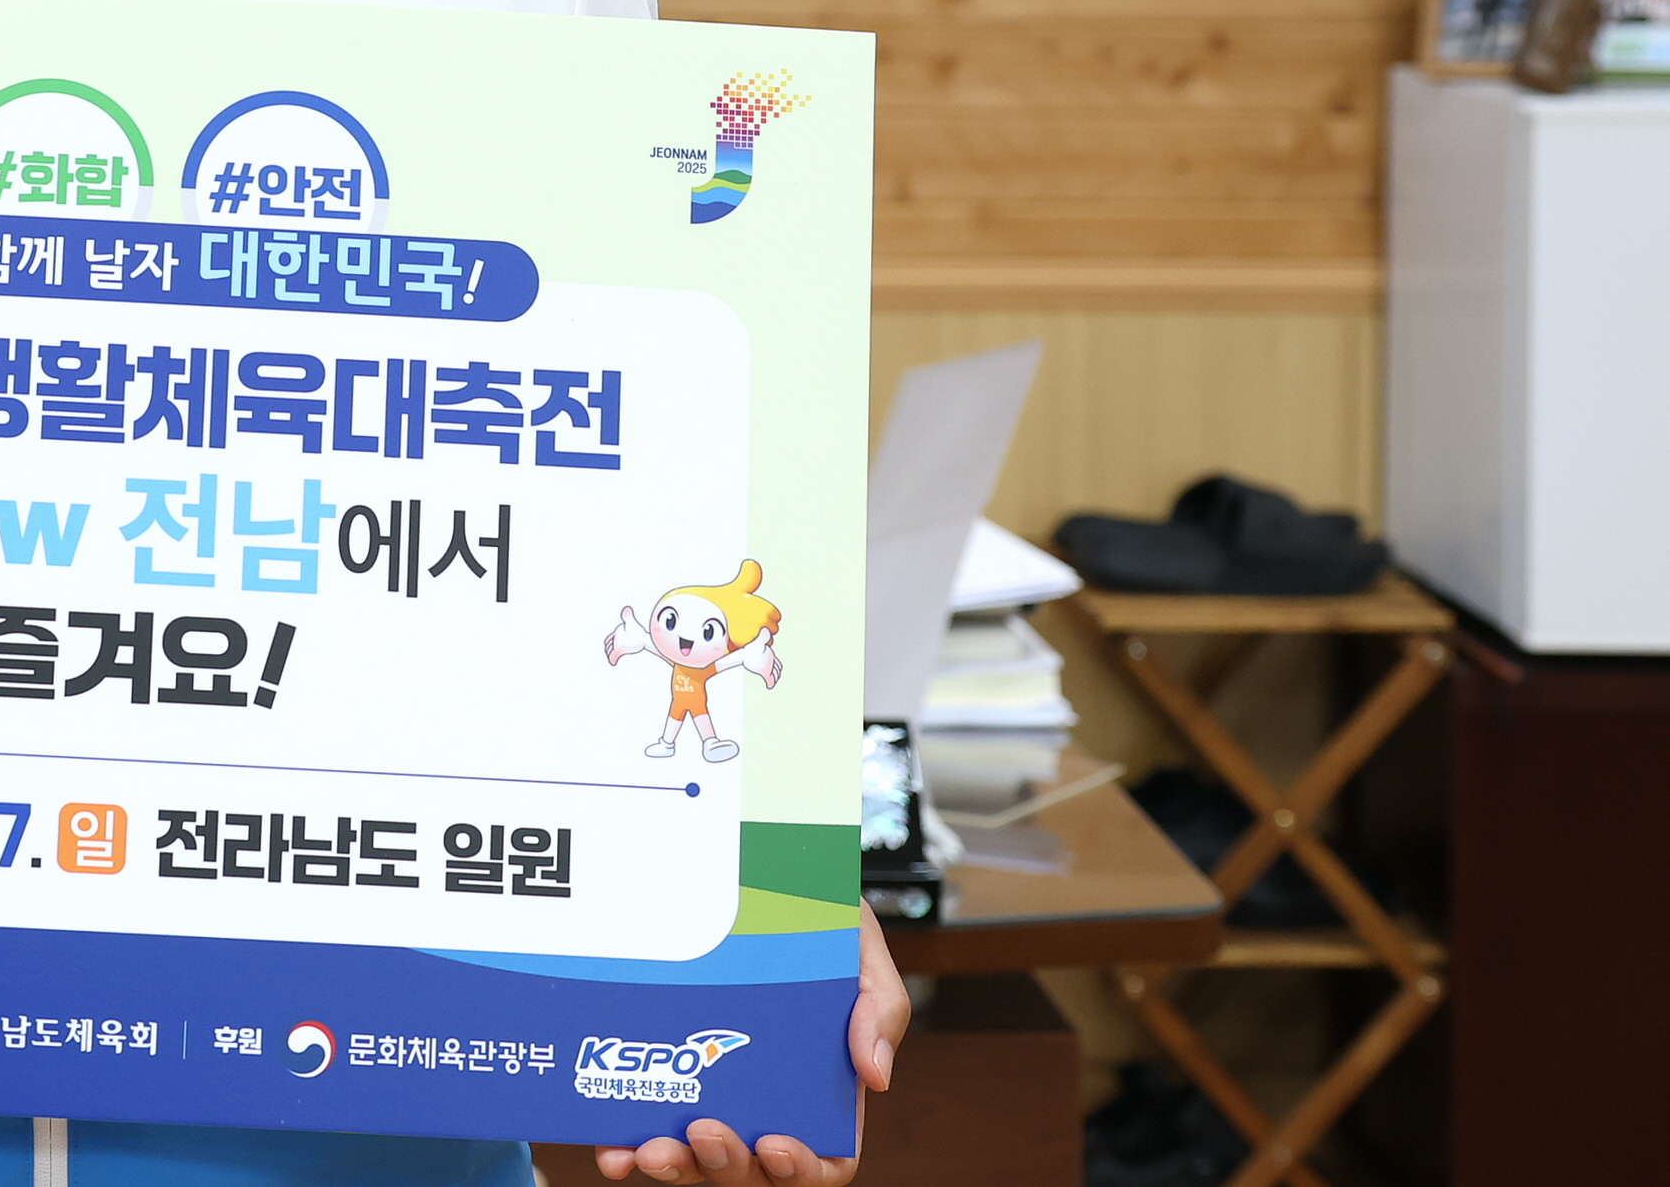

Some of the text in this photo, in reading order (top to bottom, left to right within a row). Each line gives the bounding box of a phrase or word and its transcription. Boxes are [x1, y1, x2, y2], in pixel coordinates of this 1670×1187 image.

[649, 146, 707, 160] JEONNAM
[677, 161, 707, 174] 2025
[209, 161, 363, 221] #안전
[85, 239, 180, 291] 날자
[199, 229, 486, 311] 대한민국!
[119, 474, 514, 604] 전남에서
[70, 810, 116, 868] 일
[155, 808, 420, 889] 전라남도
[442, 822, 572, 898] 일원
[213, 1025, 263, 1056] 후원
[347, 1033, 556, 1076] 문화체육관광부
[580, 1040, 700, 1074] KSPO
[577, 1076, 699, 1101] 국민체육진흥공단
